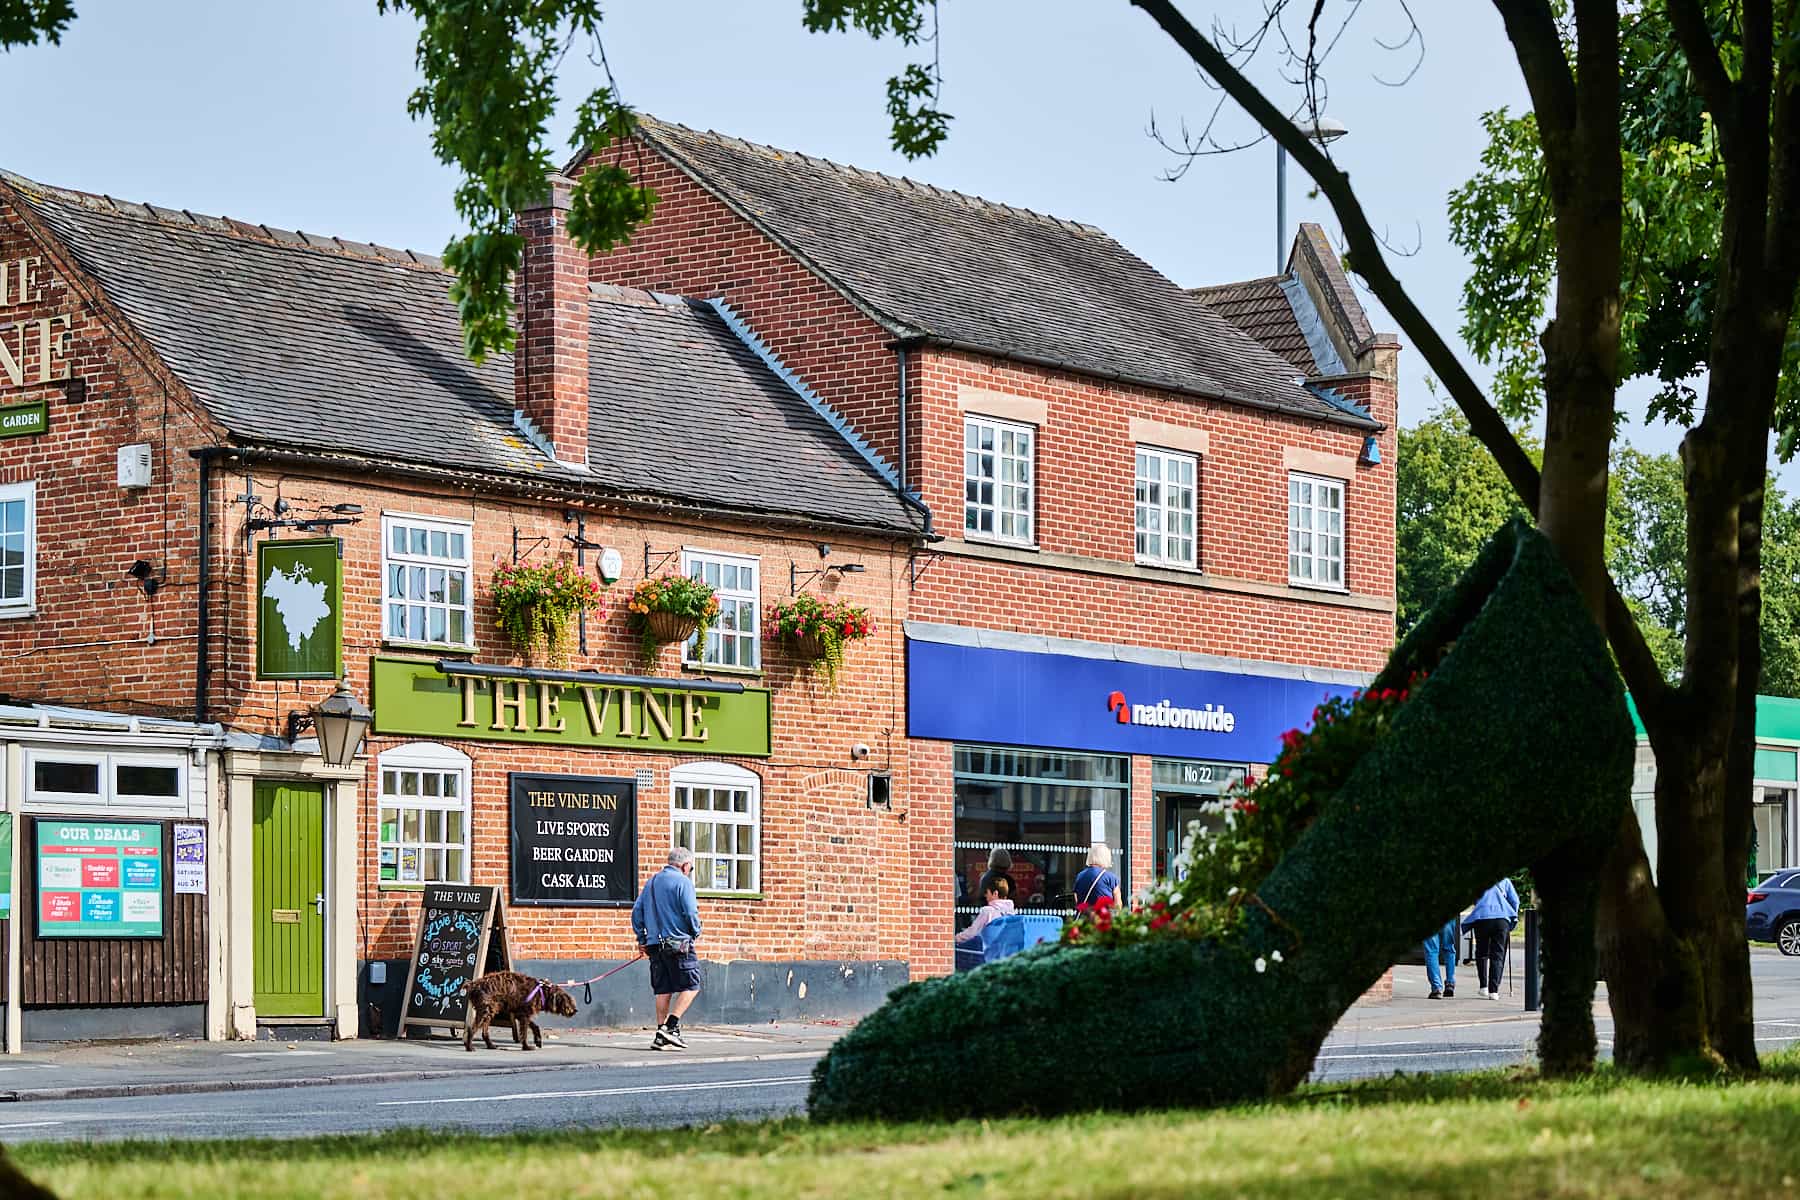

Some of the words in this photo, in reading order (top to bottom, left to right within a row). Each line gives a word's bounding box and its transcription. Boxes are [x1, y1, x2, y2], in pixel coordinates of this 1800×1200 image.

[3, 412, 40, 428] GARDEN
[451, 673, 567, 733] THE
[578, 684, 710, 742] VINE
[1131, 699, 1235, 733] nationwide
[1184, 766, 1198, 782] No
[1199, 767, 1212, 783] 22
[528, 791, 555, 807] THE
[558, 793, 590, 809] VINE
[592, 794, 617, 810] INN
[60, 827, 90, 840] OUR
[94, 828, 140, 842] DEALS
[536, 820, 564, 835] LIVE
[566, 821, 610, 837] SPORTS
[533, 847, 562, 861] BEER
[564, 848, 614, 863] GARDEN
[541, 873, 574, 887] CASK
[576, 874, 606, 888] ALES
[433, 891, 454, 902] THE
[457, 892, 481, 903] VINE
[441, 941, 464, 951] SPORT
